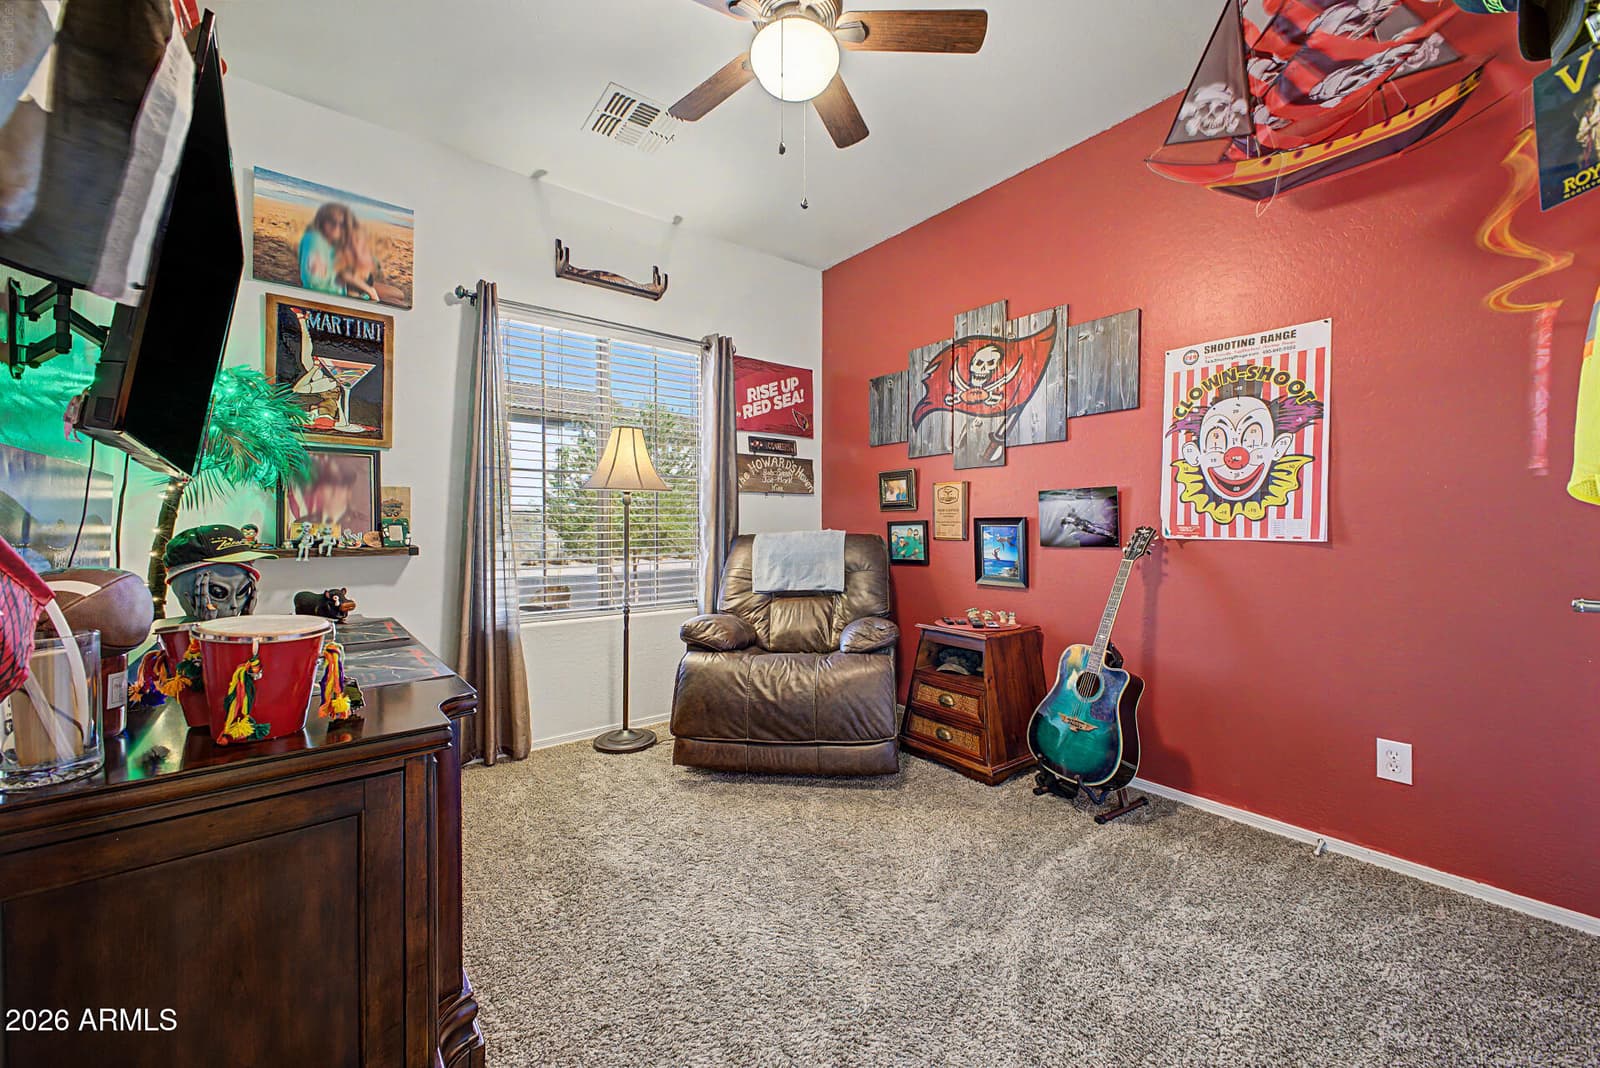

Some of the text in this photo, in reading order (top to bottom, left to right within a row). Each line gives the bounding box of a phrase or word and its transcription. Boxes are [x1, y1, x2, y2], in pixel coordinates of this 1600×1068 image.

[307, 311, 382, 342] MARTINI
[1204, 338, 1255, 354] SHOOTING
[1260, 329, 1297, 344] RANGE
[747, 376, 799, 403] RISE UP
[742, 389, 804, 419] RED SEA!
